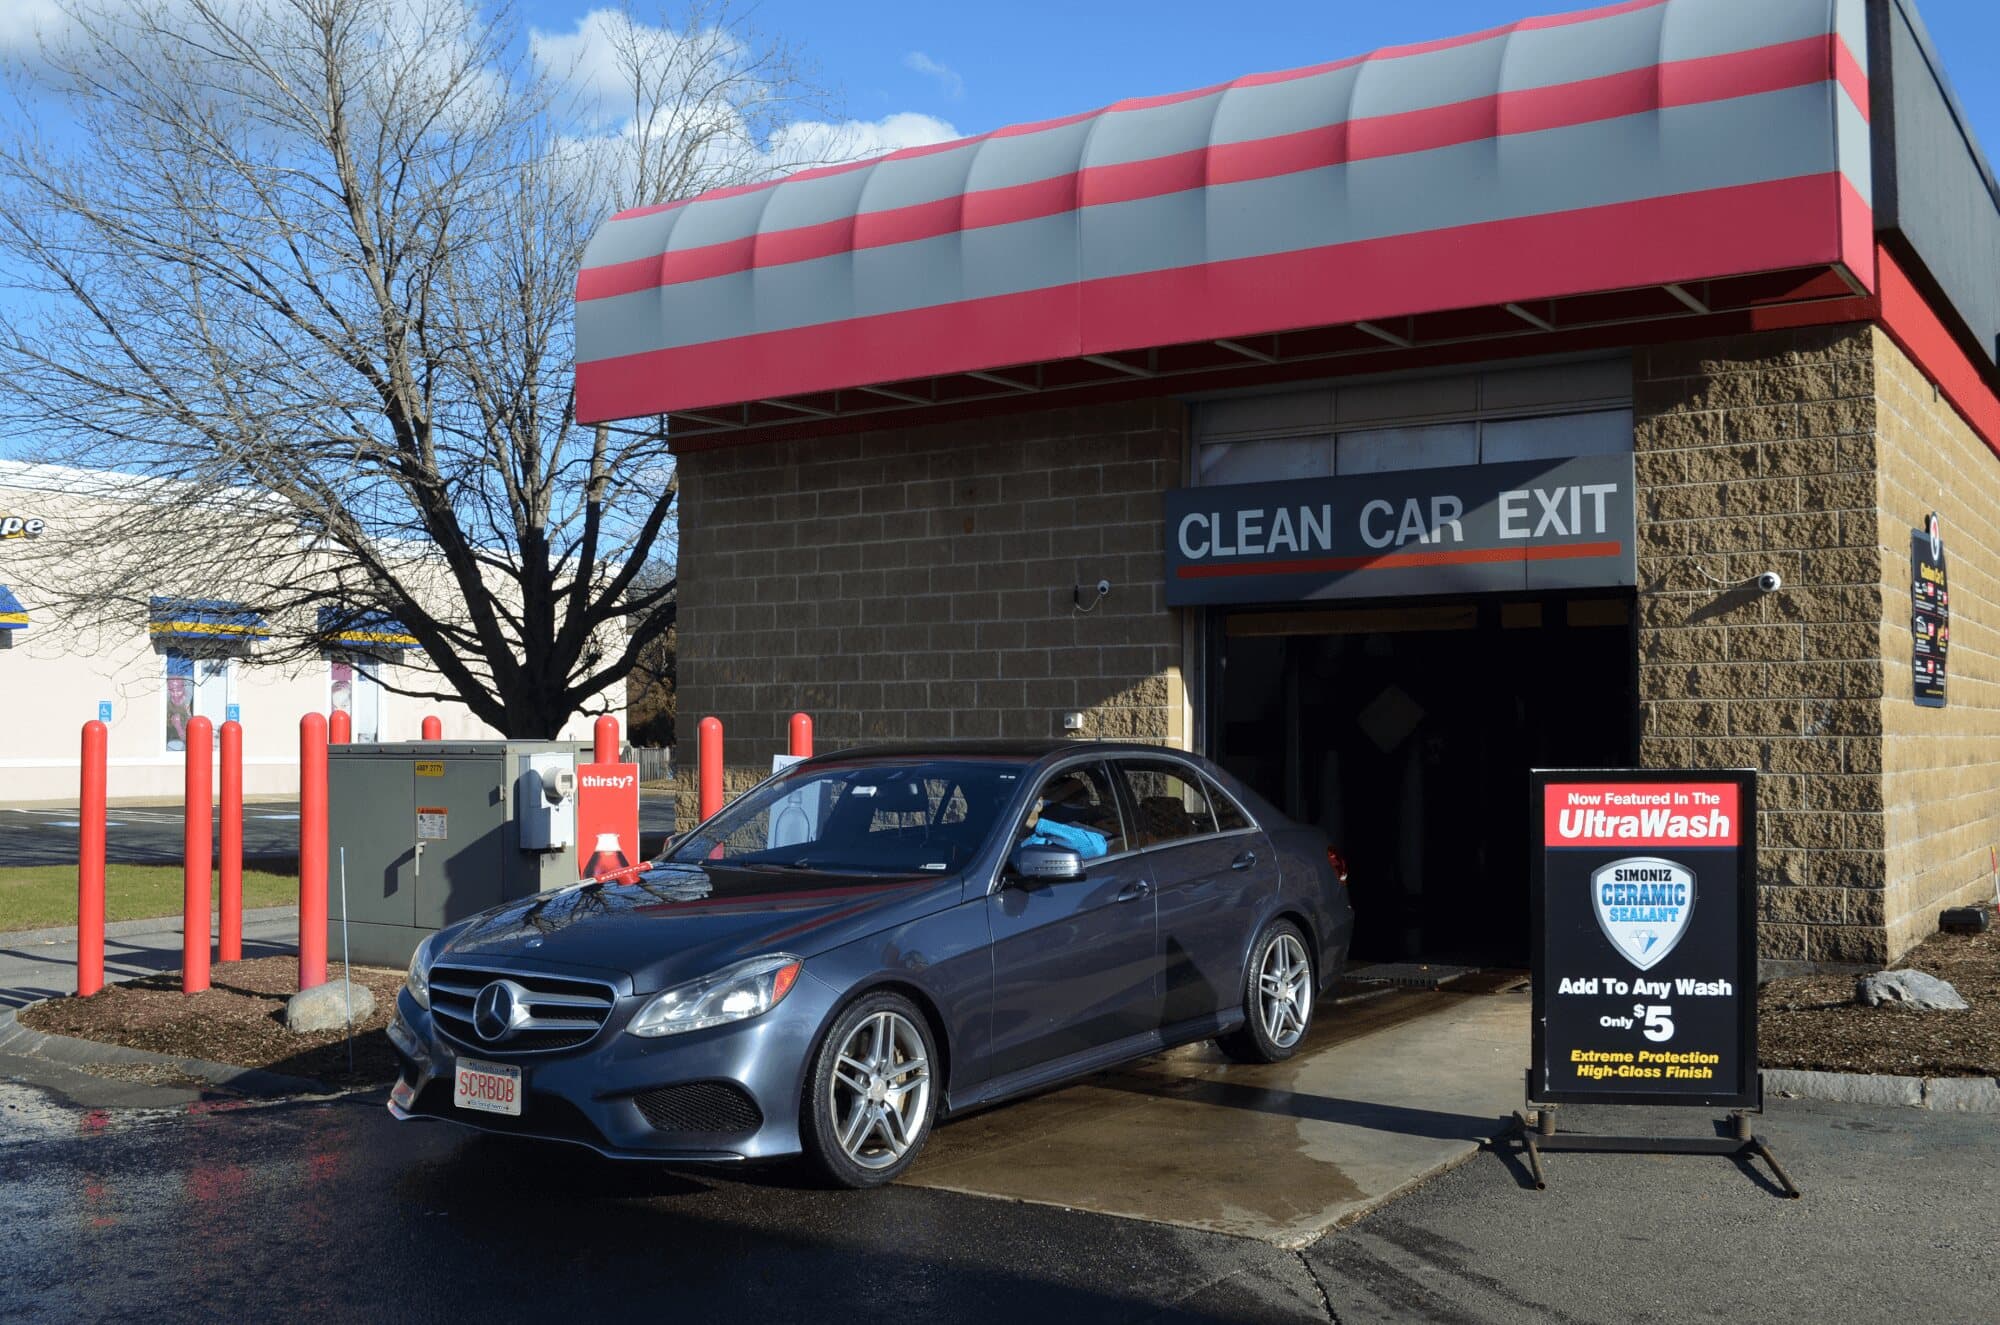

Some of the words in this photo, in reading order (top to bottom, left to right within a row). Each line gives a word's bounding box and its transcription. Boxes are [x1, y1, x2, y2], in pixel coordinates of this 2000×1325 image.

[0, 516, 45, 537] pe
[1177, 503, 1332, 560] CLEAN
[1359, 495, 1465, 549] CAR
[1499, 483, 1618, 540] EXIT
[581, 775, 634, 789] thirsty?
[1567, 792, 1601, 805] Now
[1604, 792, 1671, 805] Featured
[1674, 792, 1689, 805] In
[1692, 792, 1720, 805] The
[1558, 808, 1730, 838] UltraWash
[1614, 869, 1672, 882] SIMONIZ
[1601, 883, 1686, 906] CERAMIC
[1609, 907, 1679, 922] SEALANT
[1558, 977, 1599, 995] Add
[1602, 978, 1629, 995] To
[1632, 978, 1671, 1000] Any
[1675, 978, 1733, 996] Wash
[1600, 1015, 1634, 1030] Only
[1633, 1003, 1675, 1042] $5
[1570, 1049, 1634, 1063] Extreme
[1638, 1050, 1720, 1064] Protection
[1576, 1064, 1662, 1080] High-Gloss
[1666, 1066, 1713, 1079] Finish
[459, 1071, 515, 1103] SCRBDB
